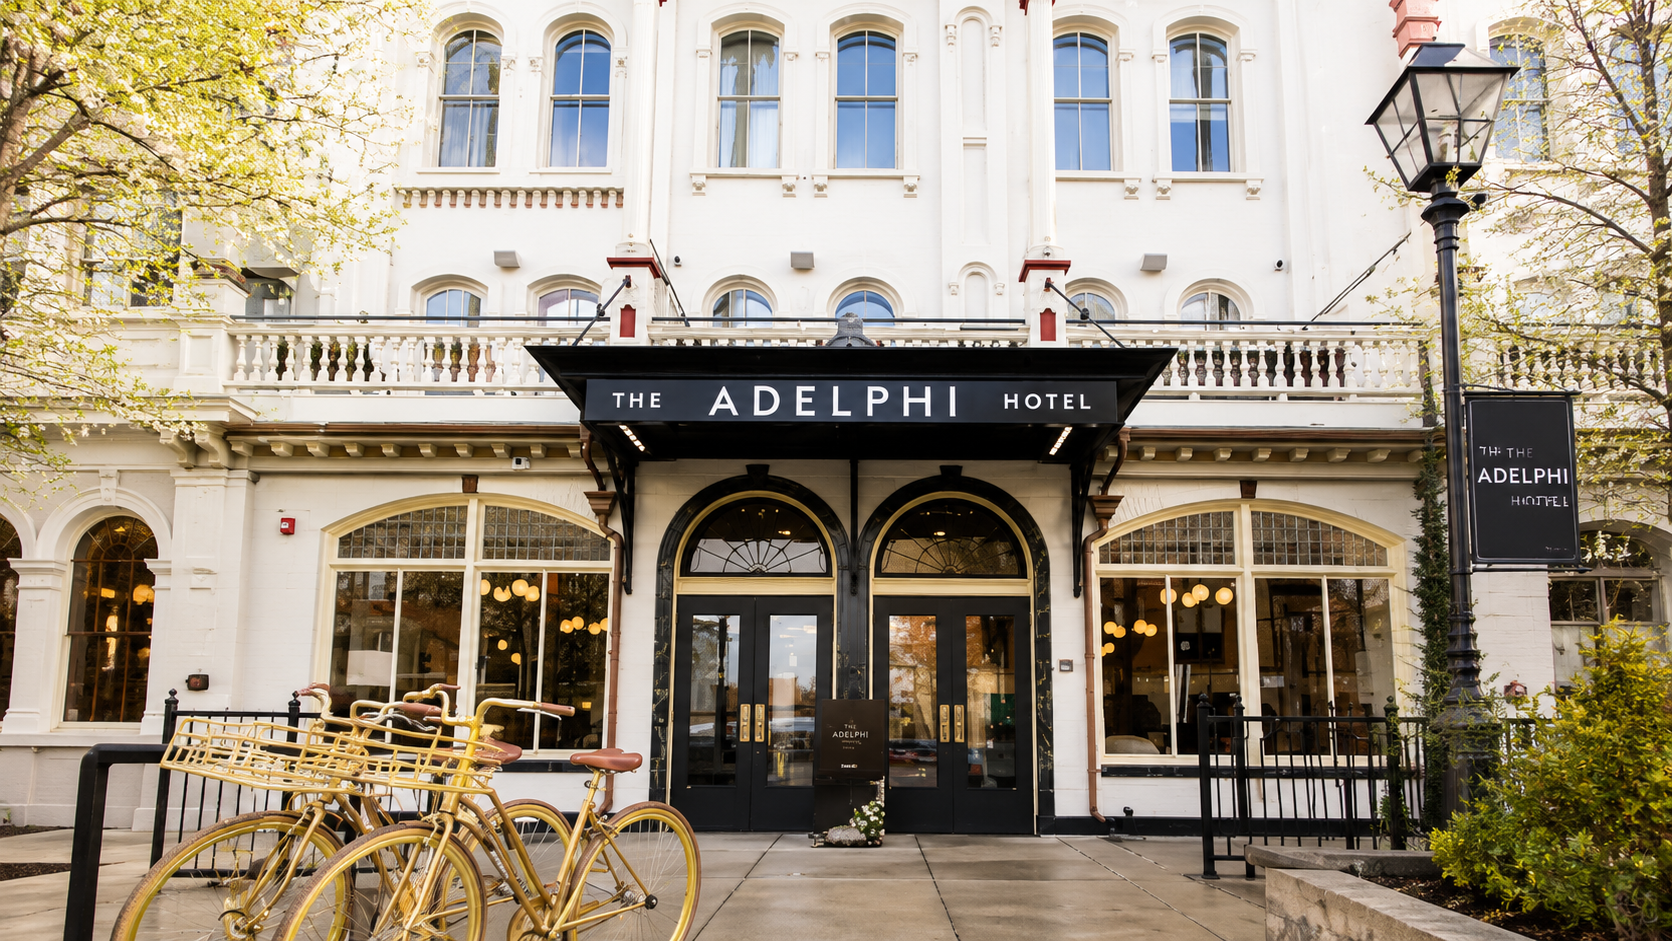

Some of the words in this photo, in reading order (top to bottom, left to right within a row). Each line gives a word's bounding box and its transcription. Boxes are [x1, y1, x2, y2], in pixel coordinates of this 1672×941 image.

[612, 392, 661, 408] THE
[708, 385, 957, 417] ADELPHI
[1004, 393, 1092, 410] HOTEL
[1506, 447, 1533, 459] THE
[1477, 467, 1568, 484] ADELPHI
[832, 730, 869, 738] ADELPHI
